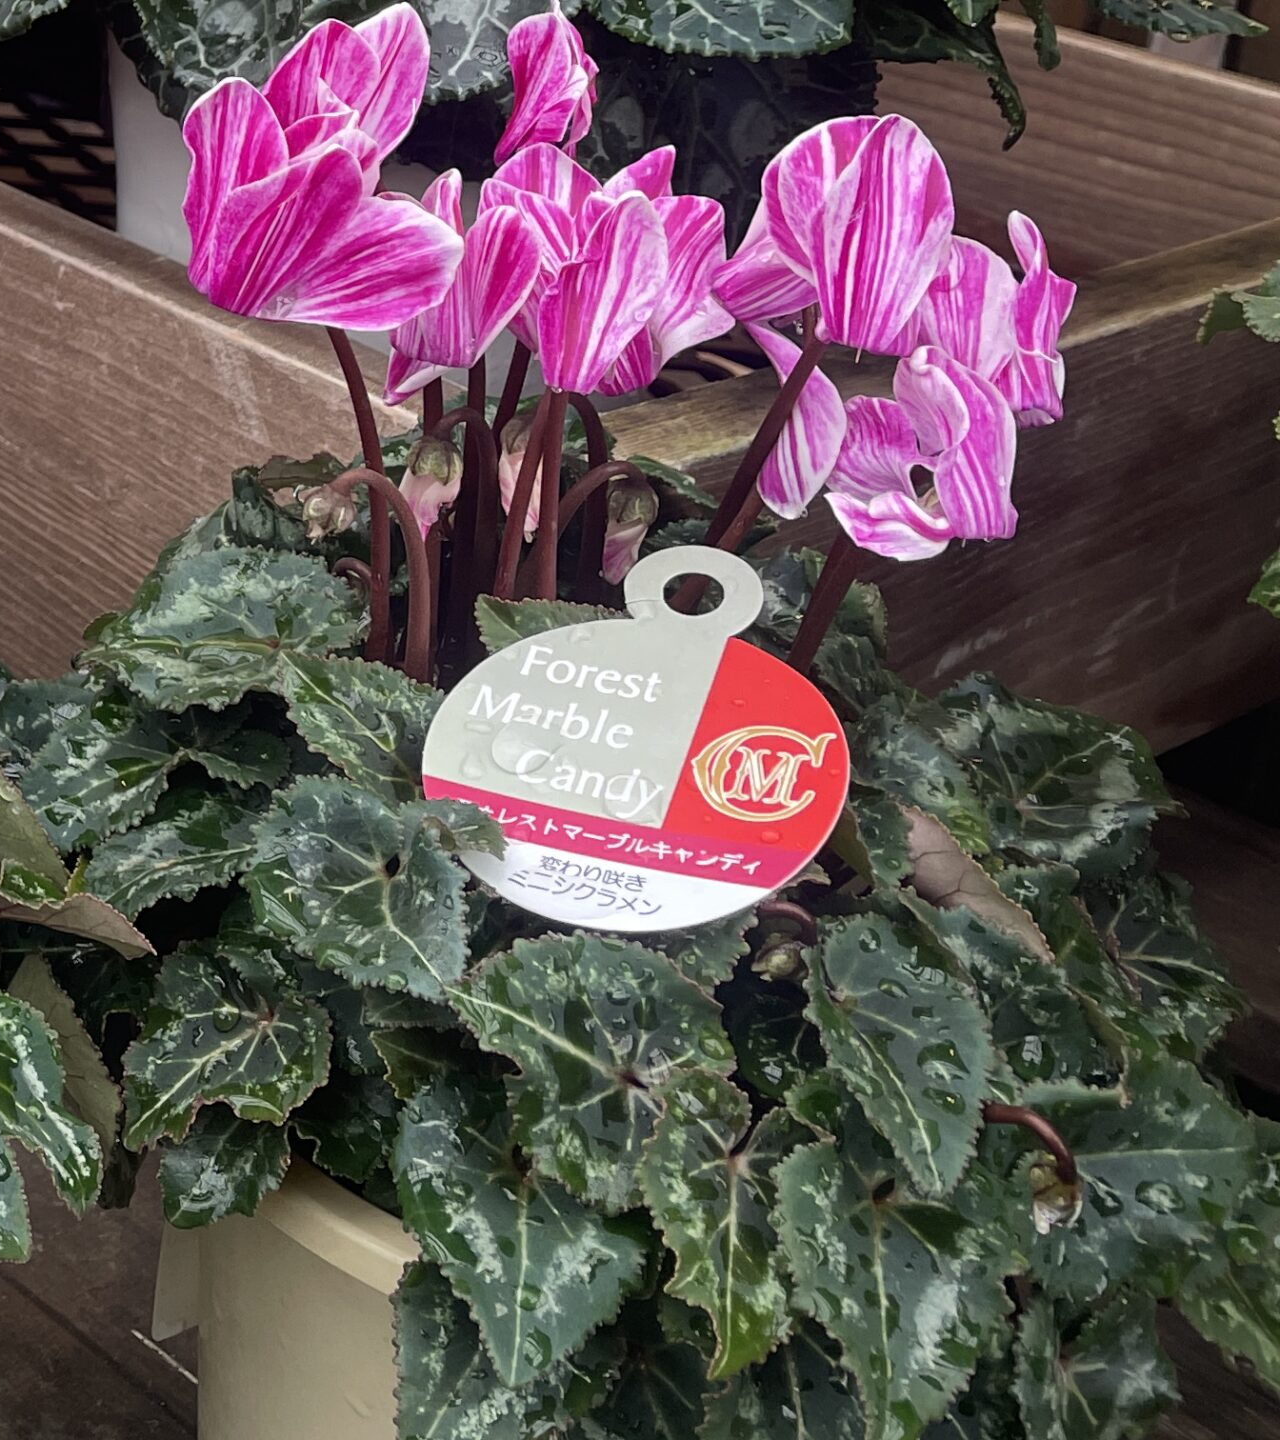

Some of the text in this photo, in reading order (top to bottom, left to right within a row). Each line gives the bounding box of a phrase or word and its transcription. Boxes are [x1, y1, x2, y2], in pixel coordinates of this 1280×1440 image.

[519, 644, 663, 703] Forest
[467, 684, 635, 749] Marble
[515, 748, 665, 820] Candy
[458, 797, 764, 876] レストマーブルキャンディ
[507, 869, 663, 916] ミニシクラメン
[539, 854, 648, 892] 変わり咲き
